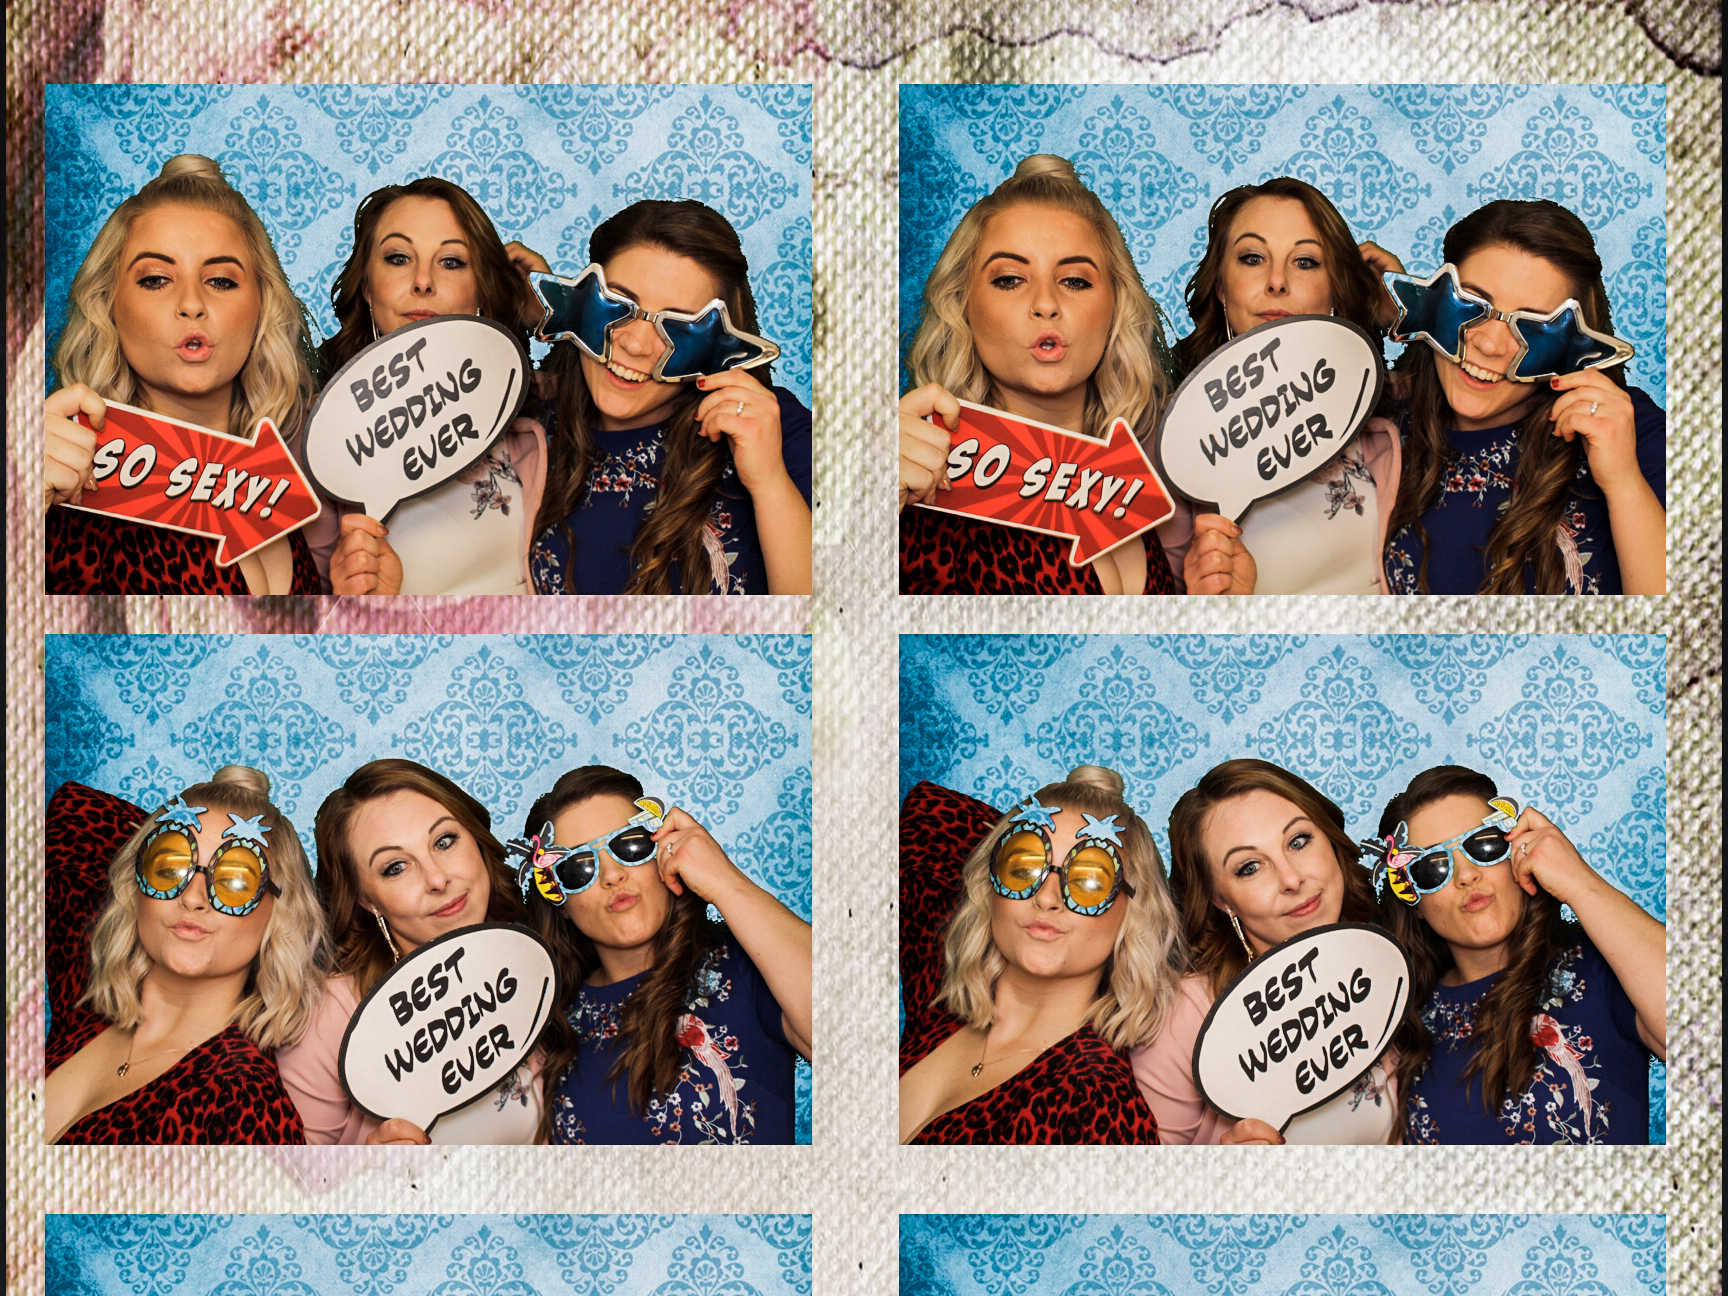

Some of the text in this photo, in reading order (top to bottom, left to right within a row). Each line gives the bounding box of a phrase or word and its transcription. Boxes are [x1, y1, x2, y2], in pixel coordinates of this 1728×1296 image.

[345, 358, 482, 467] WEDDING
[350, 337, 428, 413] BEST
[1199, 358, 1336, 467] WEDDING
[1204, 337, 1282, 413] BEST
[92, 437, 291, 522] SO SEXY!
[402, 413, 479, 481] EVER
[946, 437, 1145, 522] SO SEXY!
[1256, 413, 1333, 481] EVER
[385, 967, 517, 1082] WEDDING
[389, 947, 465, 1026] BEST
[1239, 967, 1371, 1082] WEDDING
[1243, 947, 1319, 1026] BEST
[441, 1024, 514, 1094] EVER
[1295, 1024, 1368, 1094] EVER
